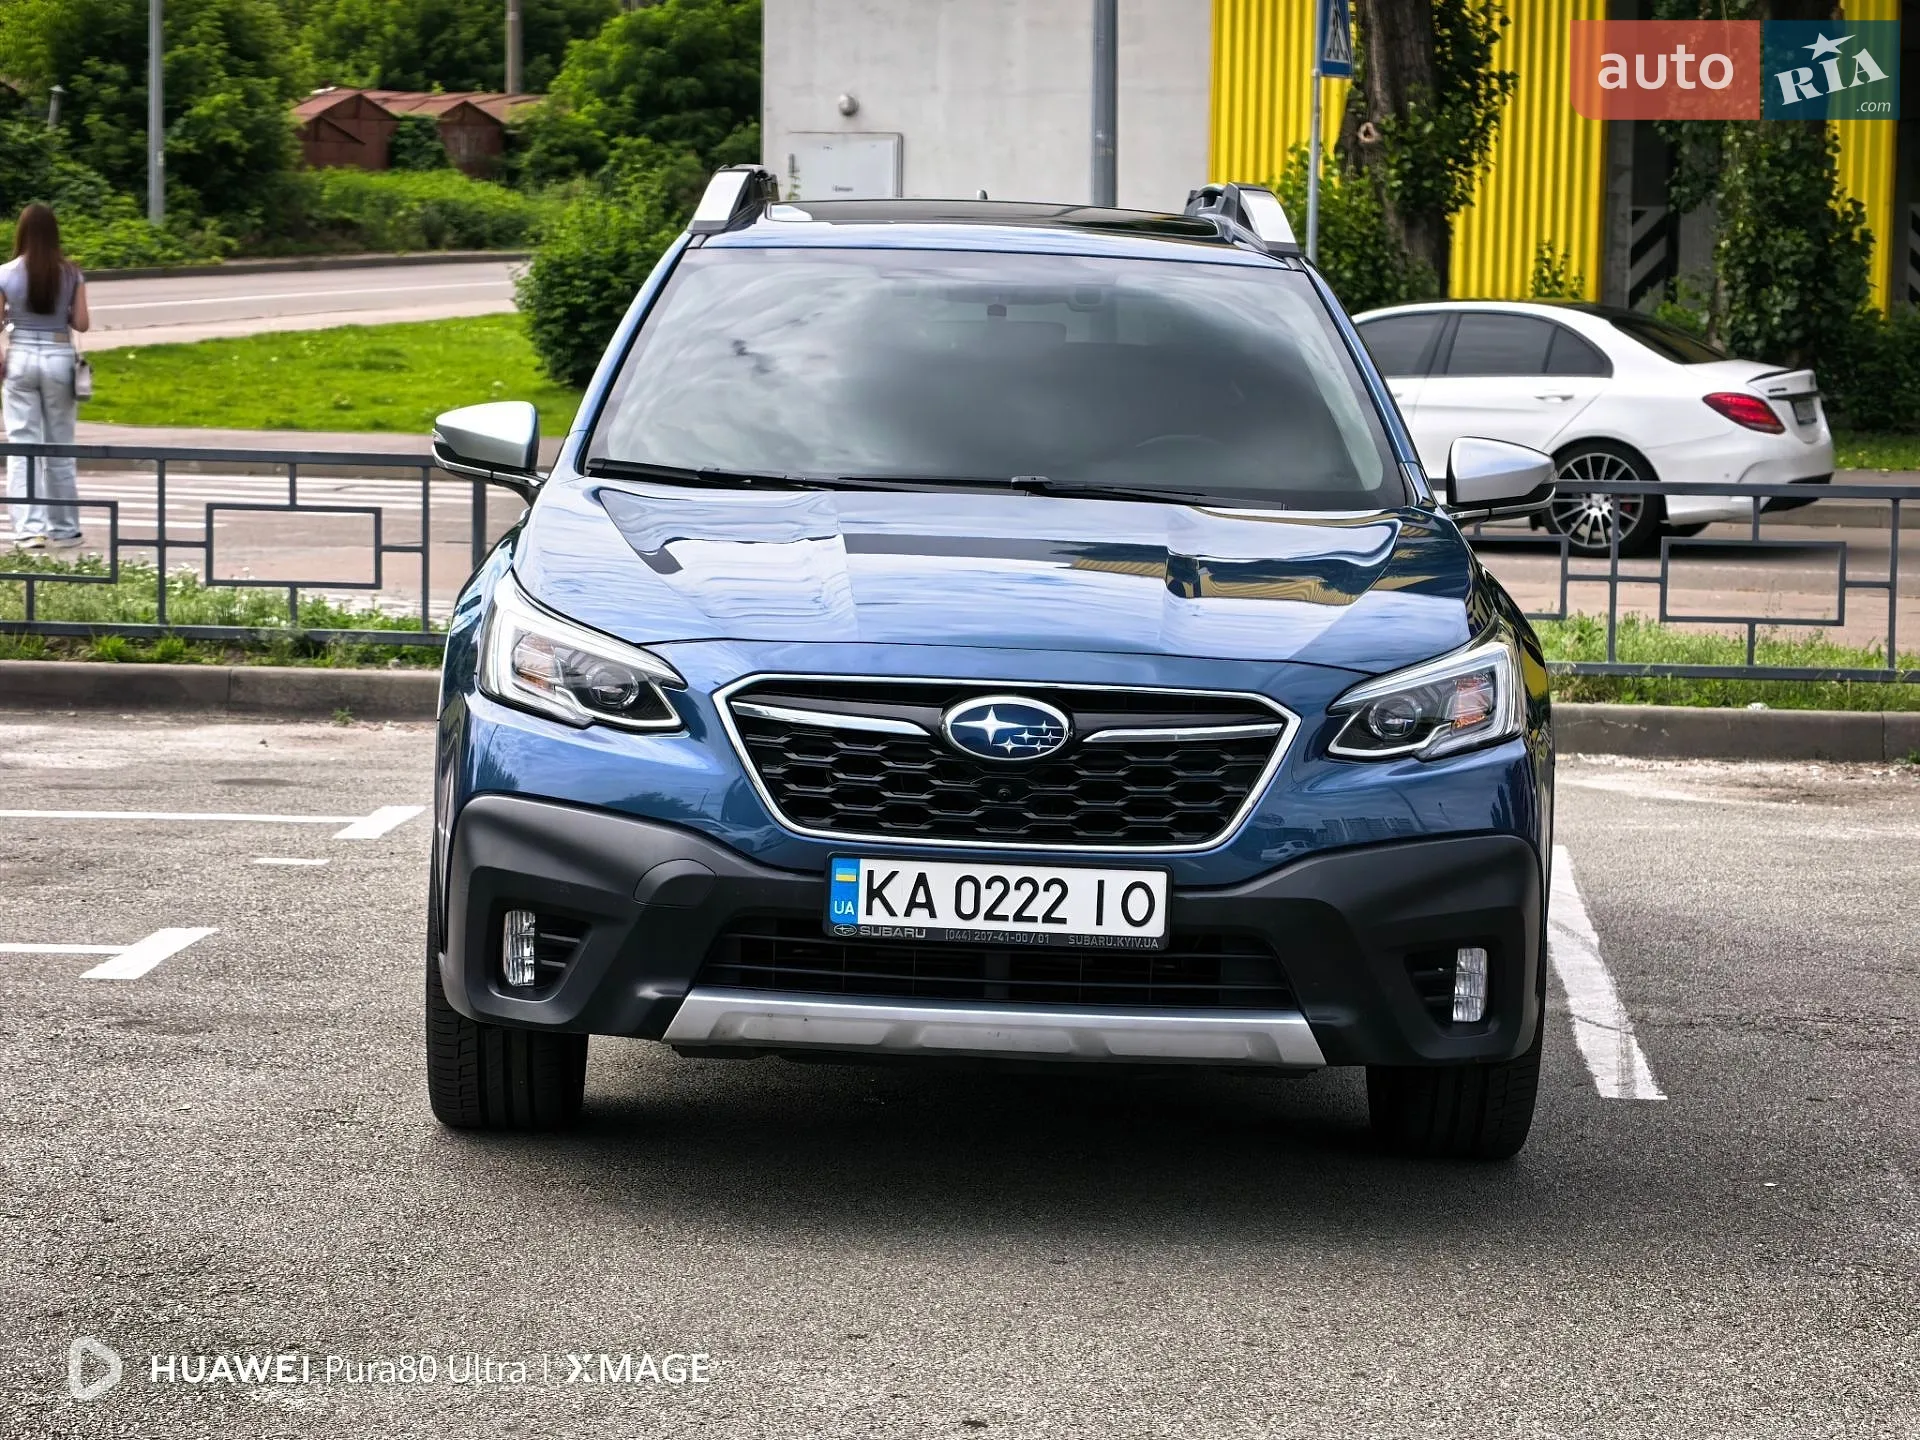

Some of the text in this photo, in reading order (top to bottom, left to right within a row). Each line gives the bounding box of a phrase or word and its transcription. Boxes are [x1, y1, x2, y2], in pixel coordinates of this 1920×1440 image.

[865, 869, 937, 919] KA
[954, 874, 1069, 925] 0222
[834, 900, 856, 916] UA
[859, 925, 926, 938] SUBARU
[1068, 935, 1159, 949] SUBARU.KYIV.UA
